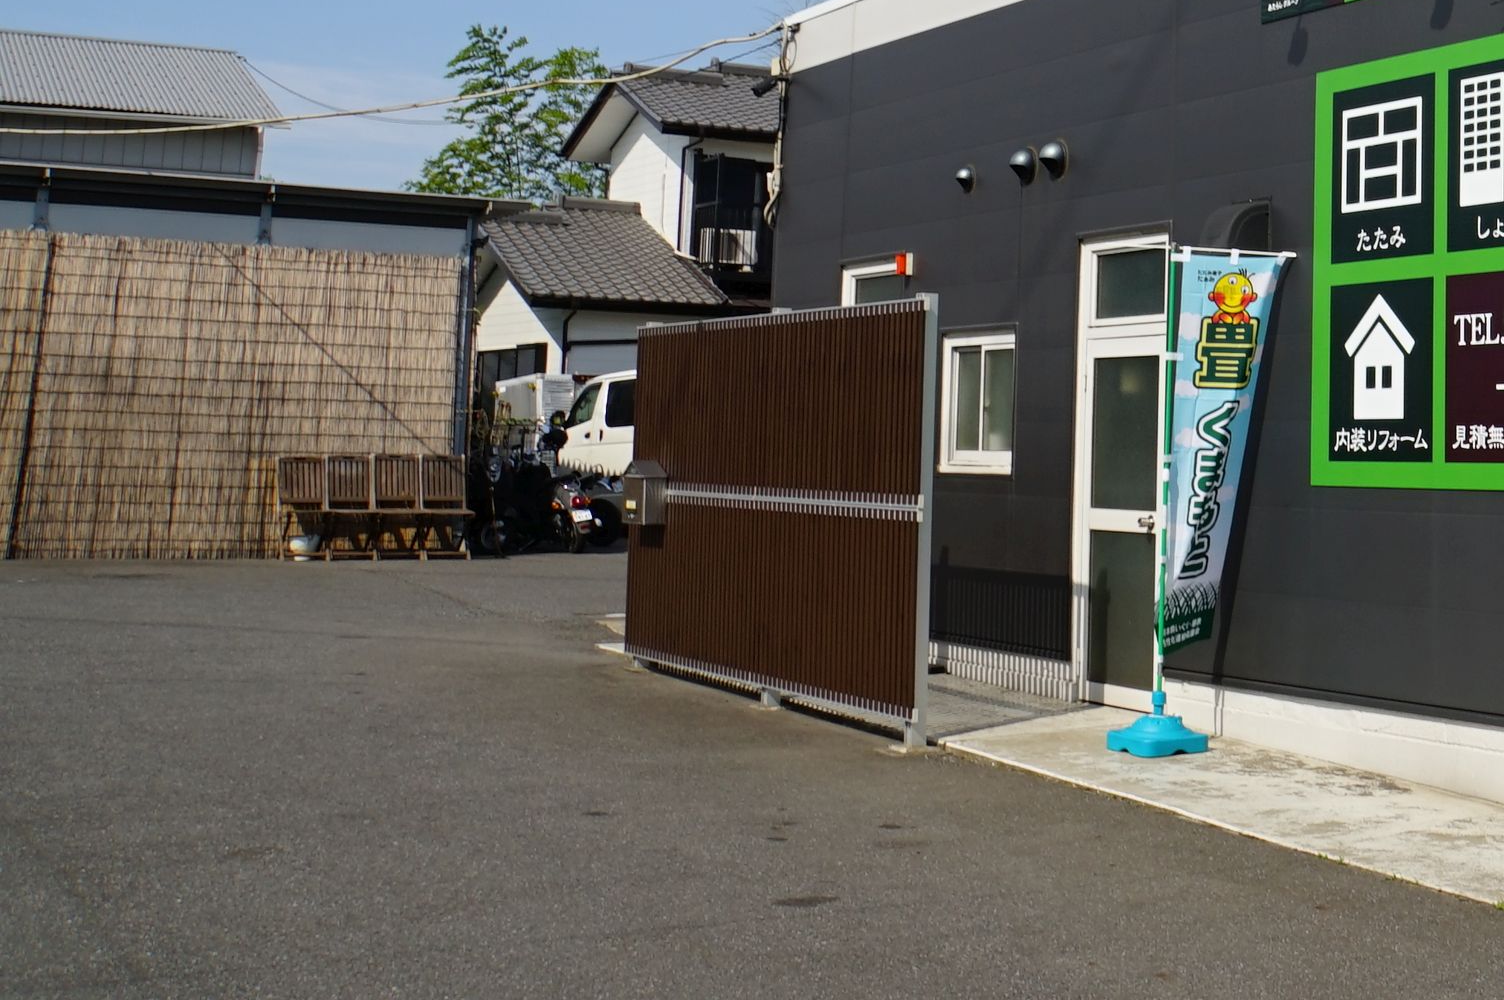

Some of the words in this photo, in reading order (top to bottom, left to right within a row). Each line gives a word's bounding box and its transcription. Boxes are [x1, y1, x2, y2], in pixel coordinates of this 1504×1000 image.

[1356, 225, 1406, 252] たたみ
[1334, 426, 1429, 452] 内装リフォーム
